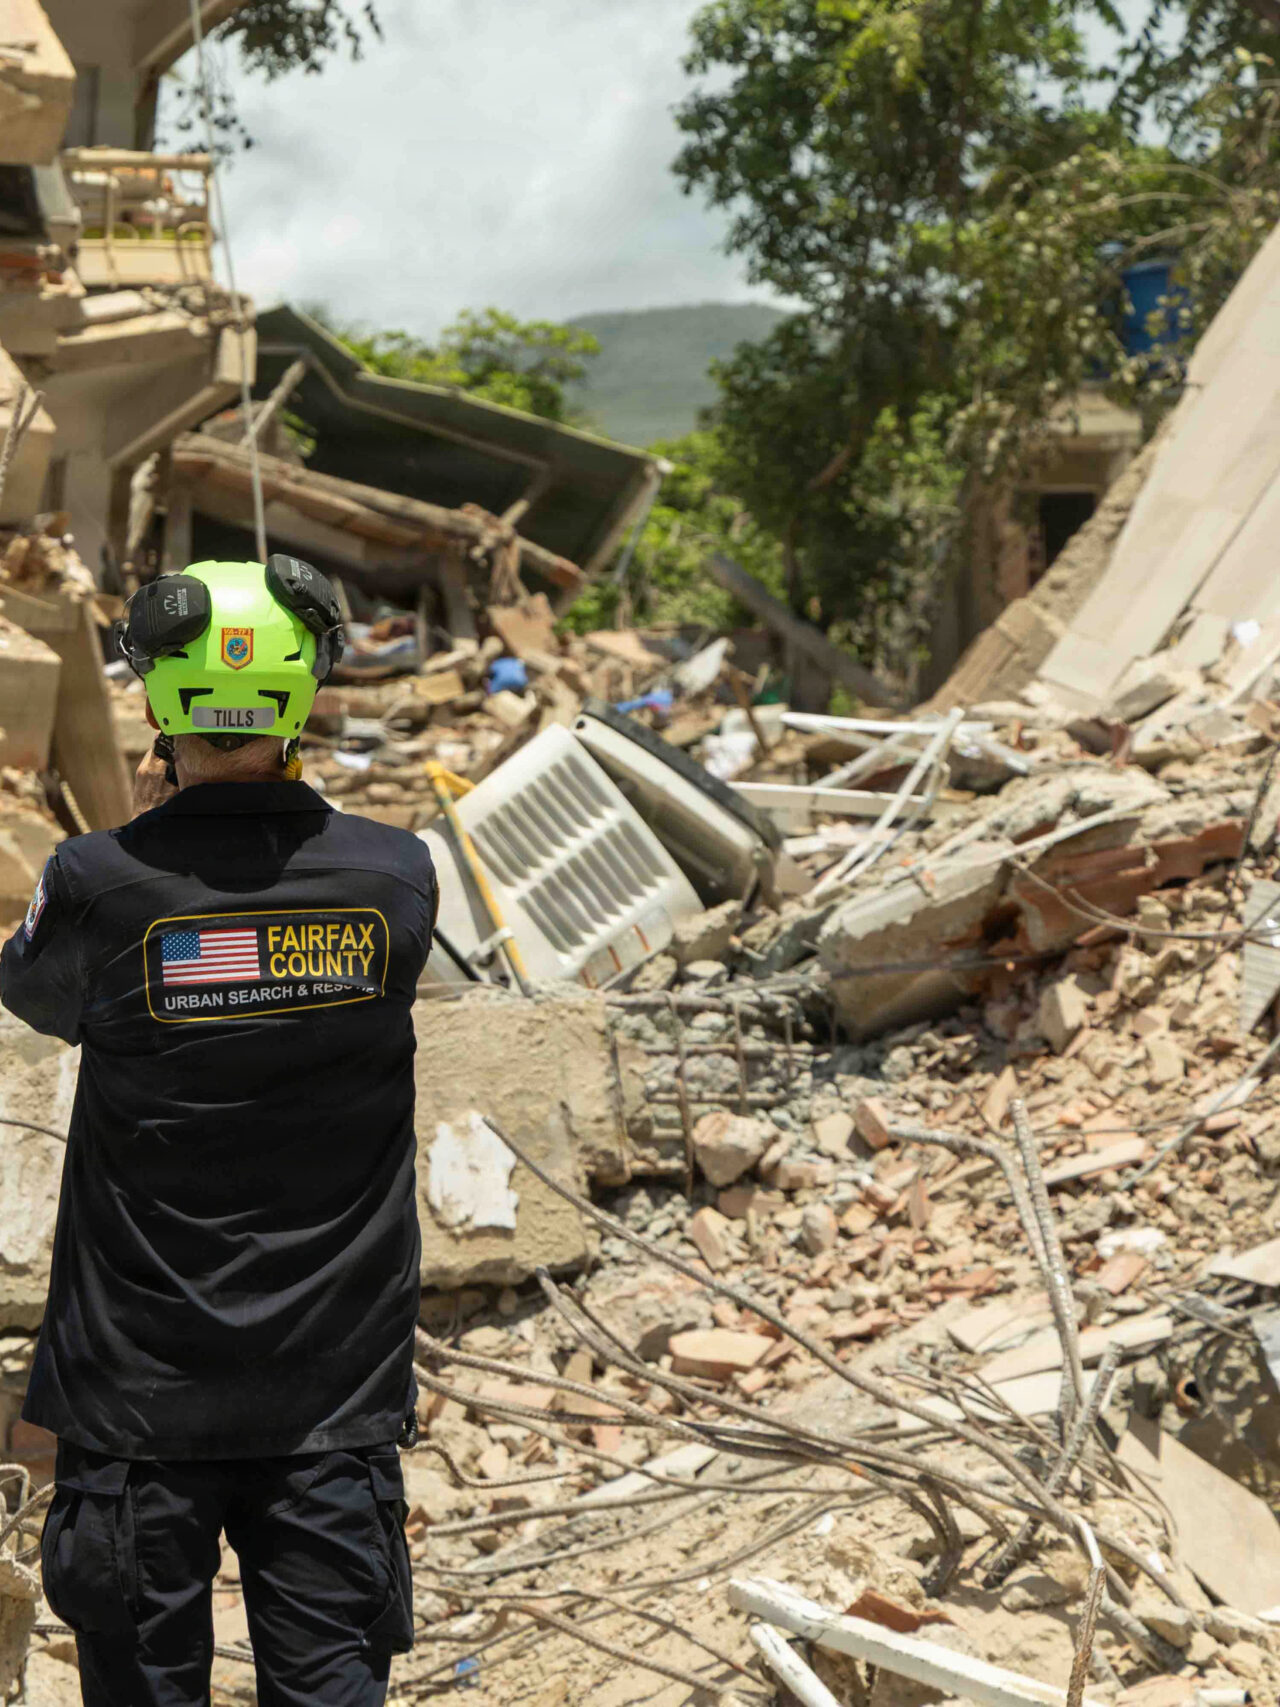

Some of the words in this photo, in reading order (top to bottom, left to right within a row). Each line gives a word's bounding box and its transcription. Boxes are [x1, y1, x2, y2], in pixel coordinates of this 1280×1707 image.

[214, 710, 254, 727] TILLS
[268, 923, 375, 952] FAIRFAX
[270, 950, 375, 978] COUNTY
[165, 992, 223, 1010] URBAN
[228, 985, 293, 1005] SEARCH
[297, 984, 308, 996] &
